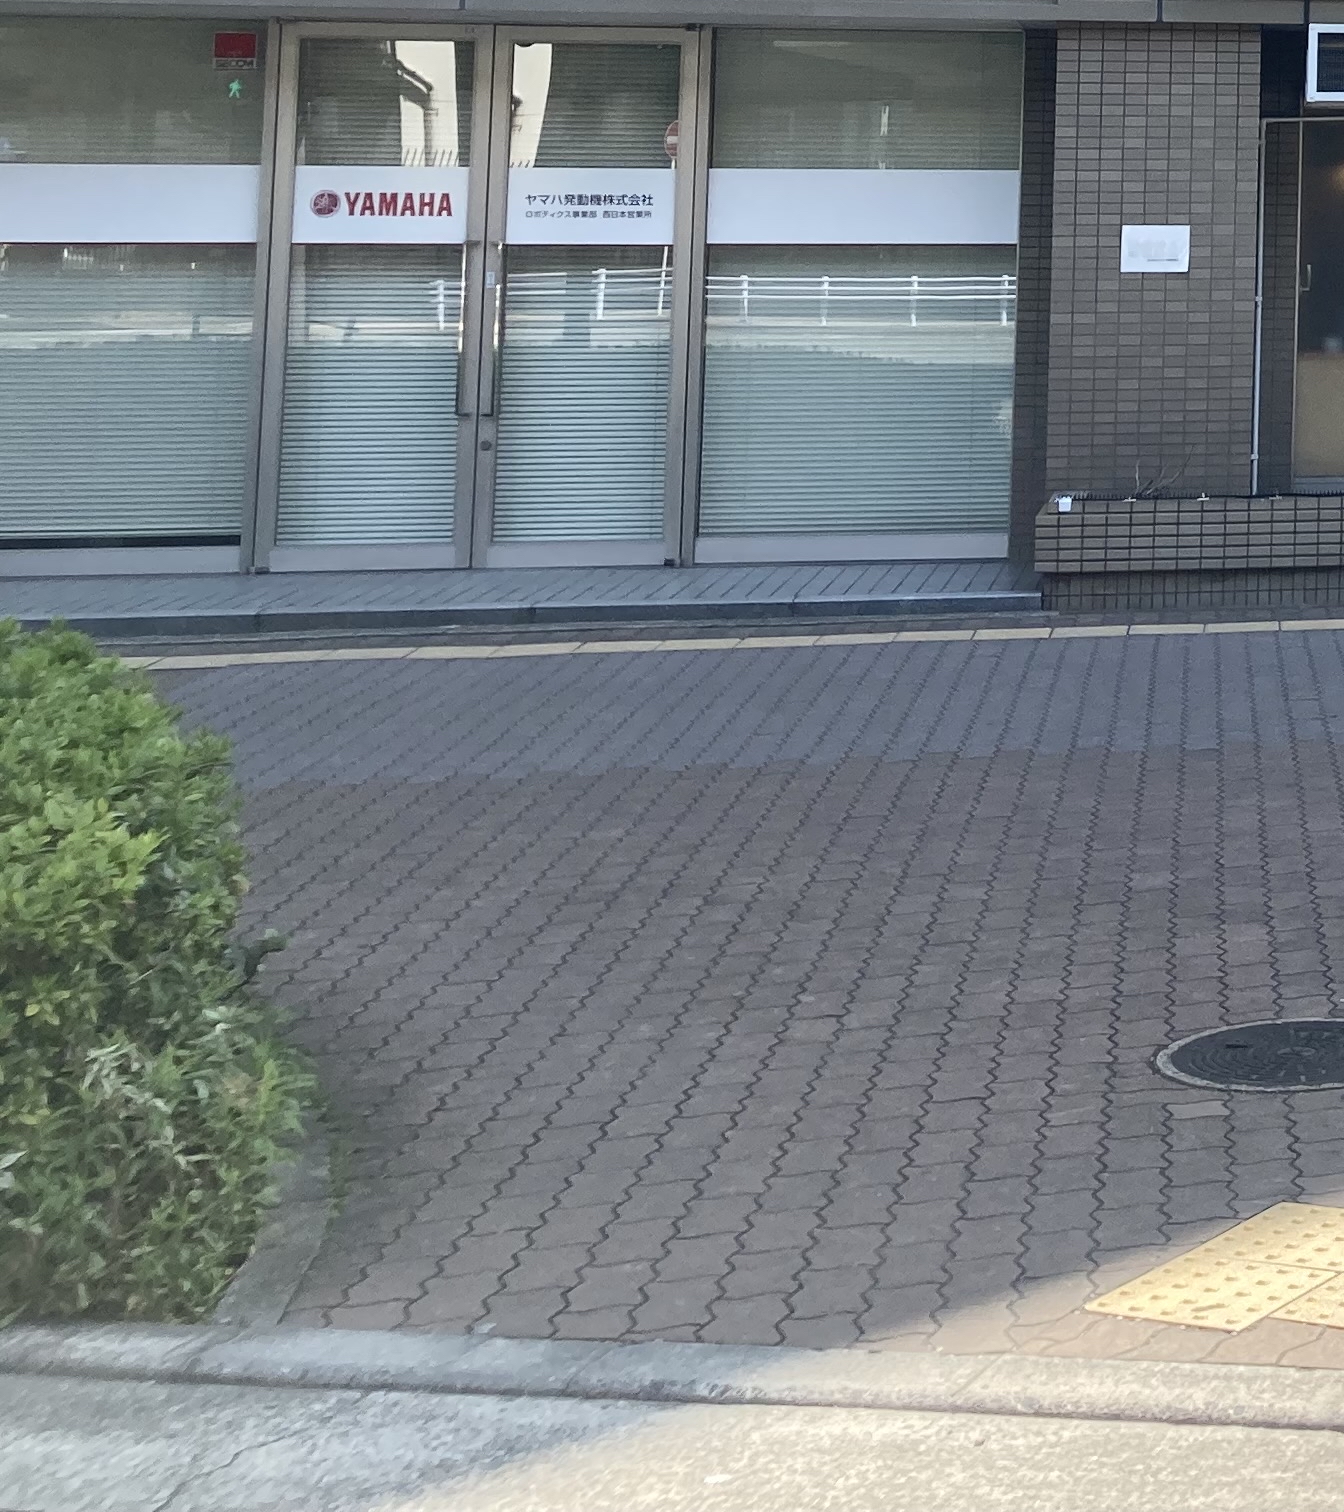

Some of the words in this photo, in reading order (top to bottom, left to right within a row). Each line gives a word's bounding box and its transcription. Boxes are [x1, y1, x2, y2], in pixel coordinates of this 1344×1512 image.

[344, 192, 453, 217] YAMAHA
[525, 194, 654, 206] ヤマハ発動機株式会社
